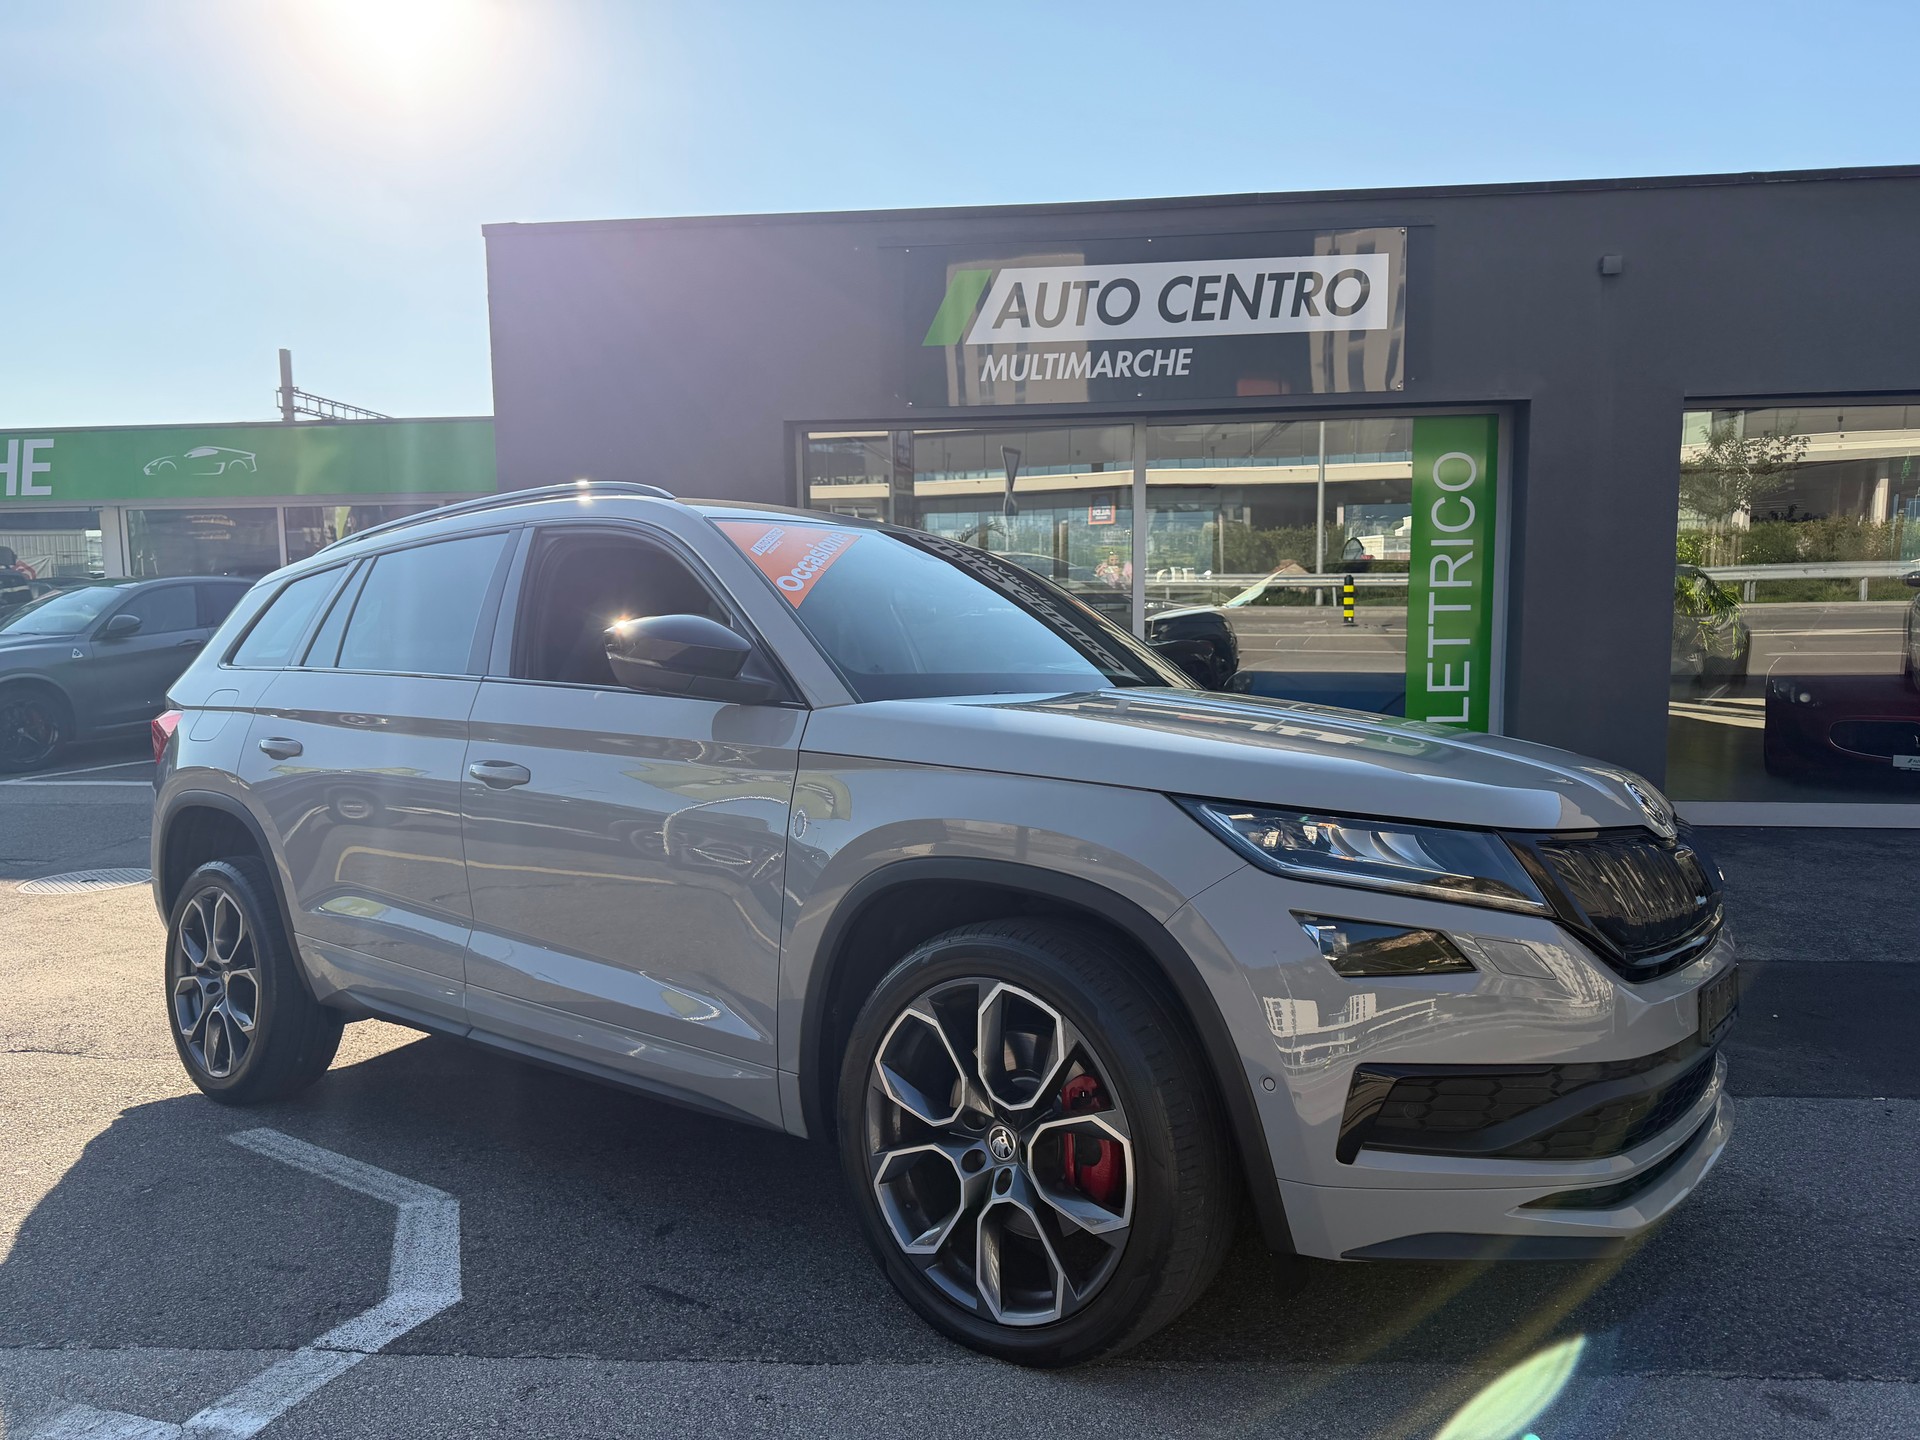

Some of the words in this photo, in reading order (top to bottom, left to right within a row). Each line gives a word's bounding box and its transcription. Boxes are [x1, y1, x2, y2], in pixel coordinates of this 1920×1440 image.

[991, 278, 1141, 329] AUTO
[1157, 268, 1371, 324] CENTRO
[980, 348, 1194, 382] MULTIMARCHE
[776, 532, 850, 592] Occasione
[1425, 451, 1477, 728] LETTRICO
[1012, 589, 1125, 671] CENTRO
